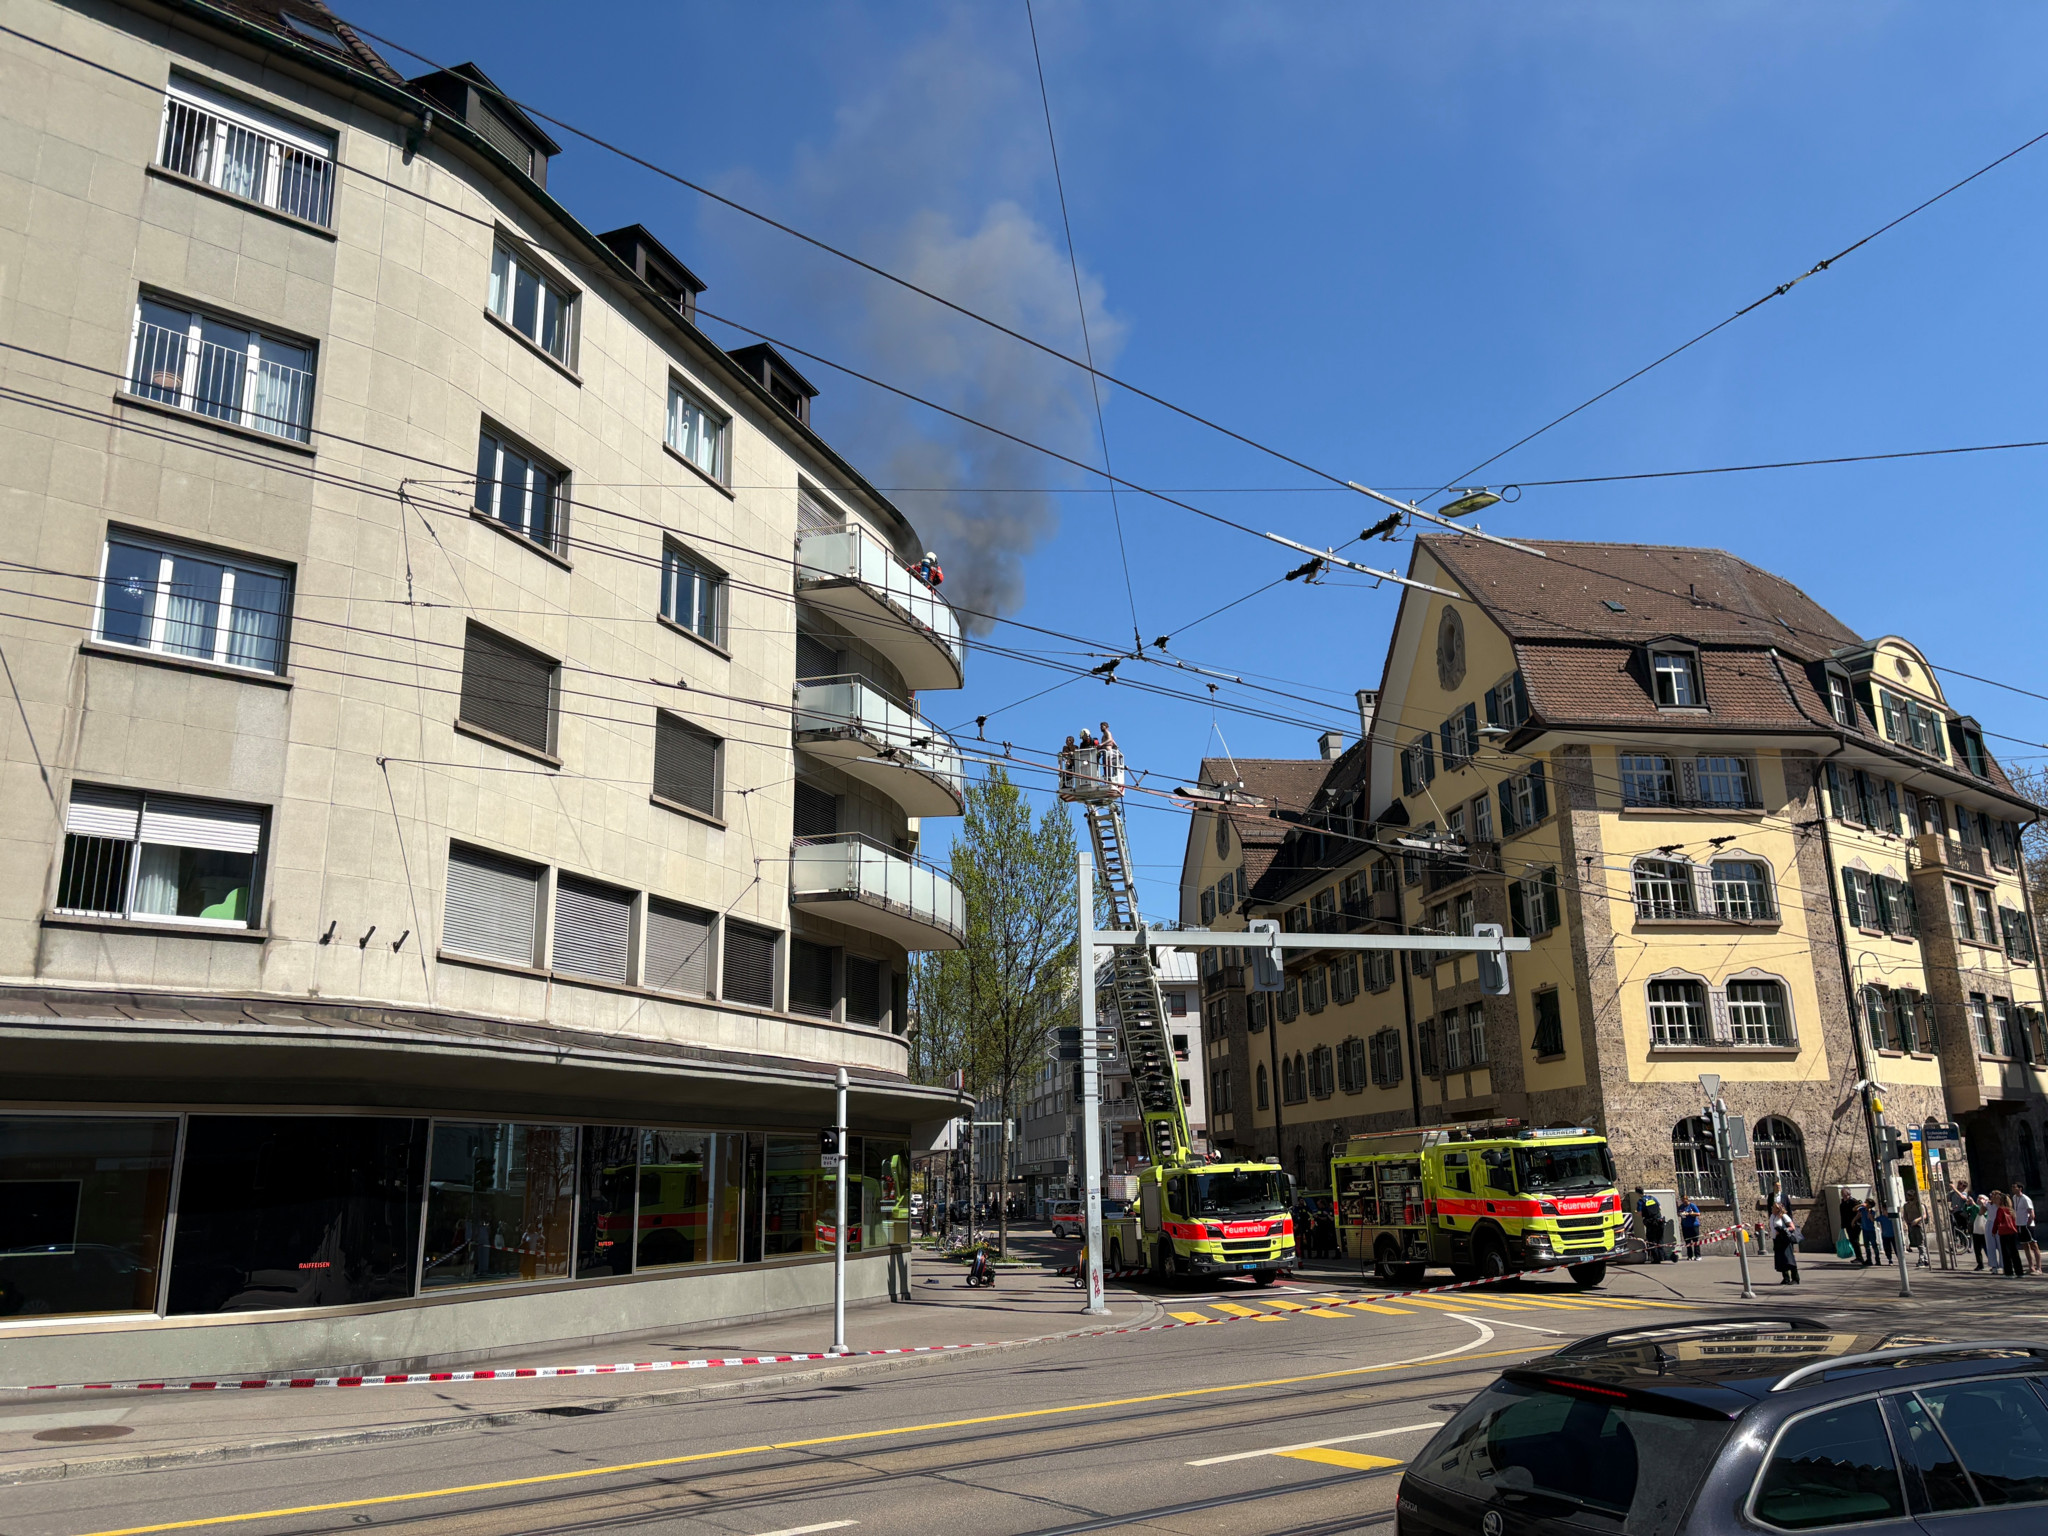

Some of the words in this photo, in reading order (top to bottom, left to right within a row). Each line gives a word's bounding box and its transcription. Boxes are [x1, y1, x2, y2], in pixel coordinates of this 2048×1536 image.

[1542, 1128, 1577, 1136] FEUERWEHR
[1557, 1200, 1599, 1210] Feuerwehr
[1223, 1224, 1267, 1234] Feuerwehr
[298, 1261, 331, 1269] RAIFFEISEN
